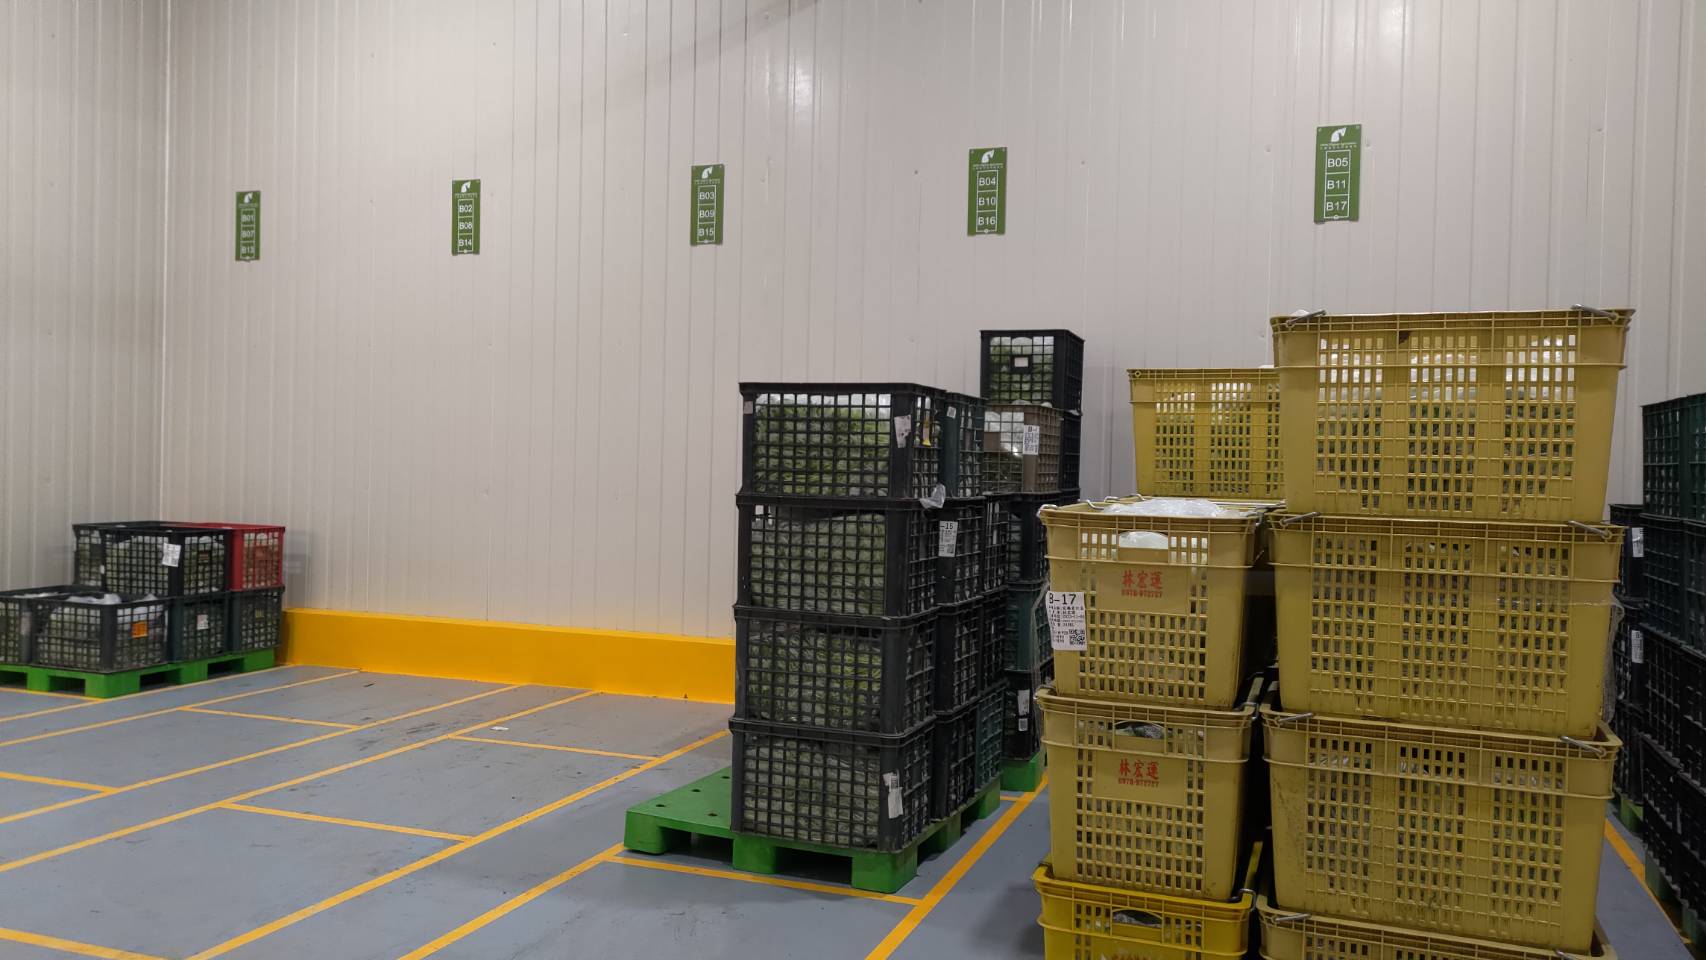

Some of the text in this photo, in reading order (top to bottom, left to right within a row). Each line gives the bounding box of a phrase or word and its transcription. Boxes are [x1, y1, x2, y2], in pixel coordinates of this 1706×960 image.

[1327, 157, 1349, 168] B05
[979, 177, 997, 186] B04
[1327, 179, 1347, 190] B11
[700, 191, 715, 200] B03
[978, 197, 996, 206] B10
[1326, 200, 1347, 211] B17
[459, 204, 473, 213] B02
[699, 209, 715, 218] B09
[459, 221, 473, 230] B08
[978, 216, 996, 226] B16
[698, 227, 714, 237] B15
[458, 239, 472, 247] B14
